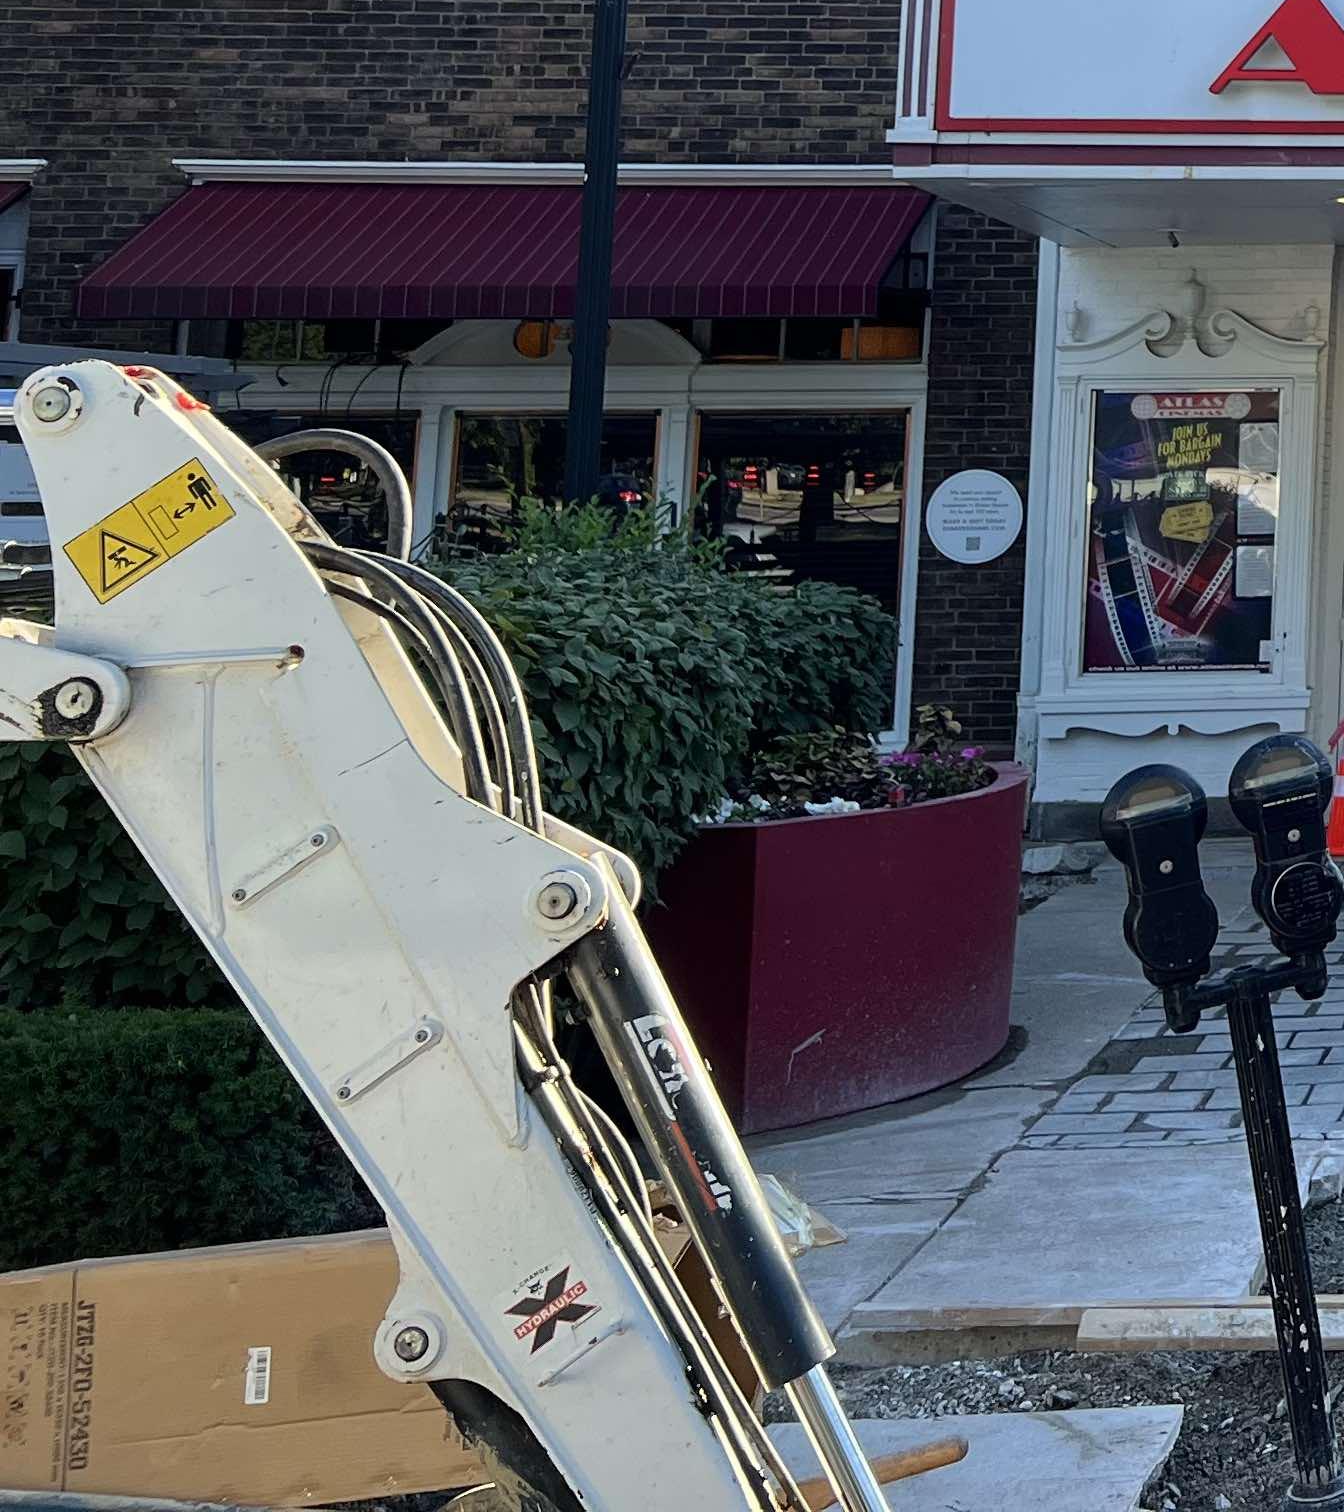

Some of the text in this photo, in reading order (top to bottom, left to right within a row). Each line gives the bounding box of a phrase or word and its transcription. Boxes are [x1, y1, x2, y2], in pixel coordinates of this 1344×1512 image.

[1162, 396, 1223, 407] ATLAS
[1172, 422, 1209, 442] JOIN US
[1157, 433, 1222, 457] FOR BARGAIN
[1166, 448, 1212, 469] MONDAYS
[515, 1282, 587, 1338] HYDRAULIC
